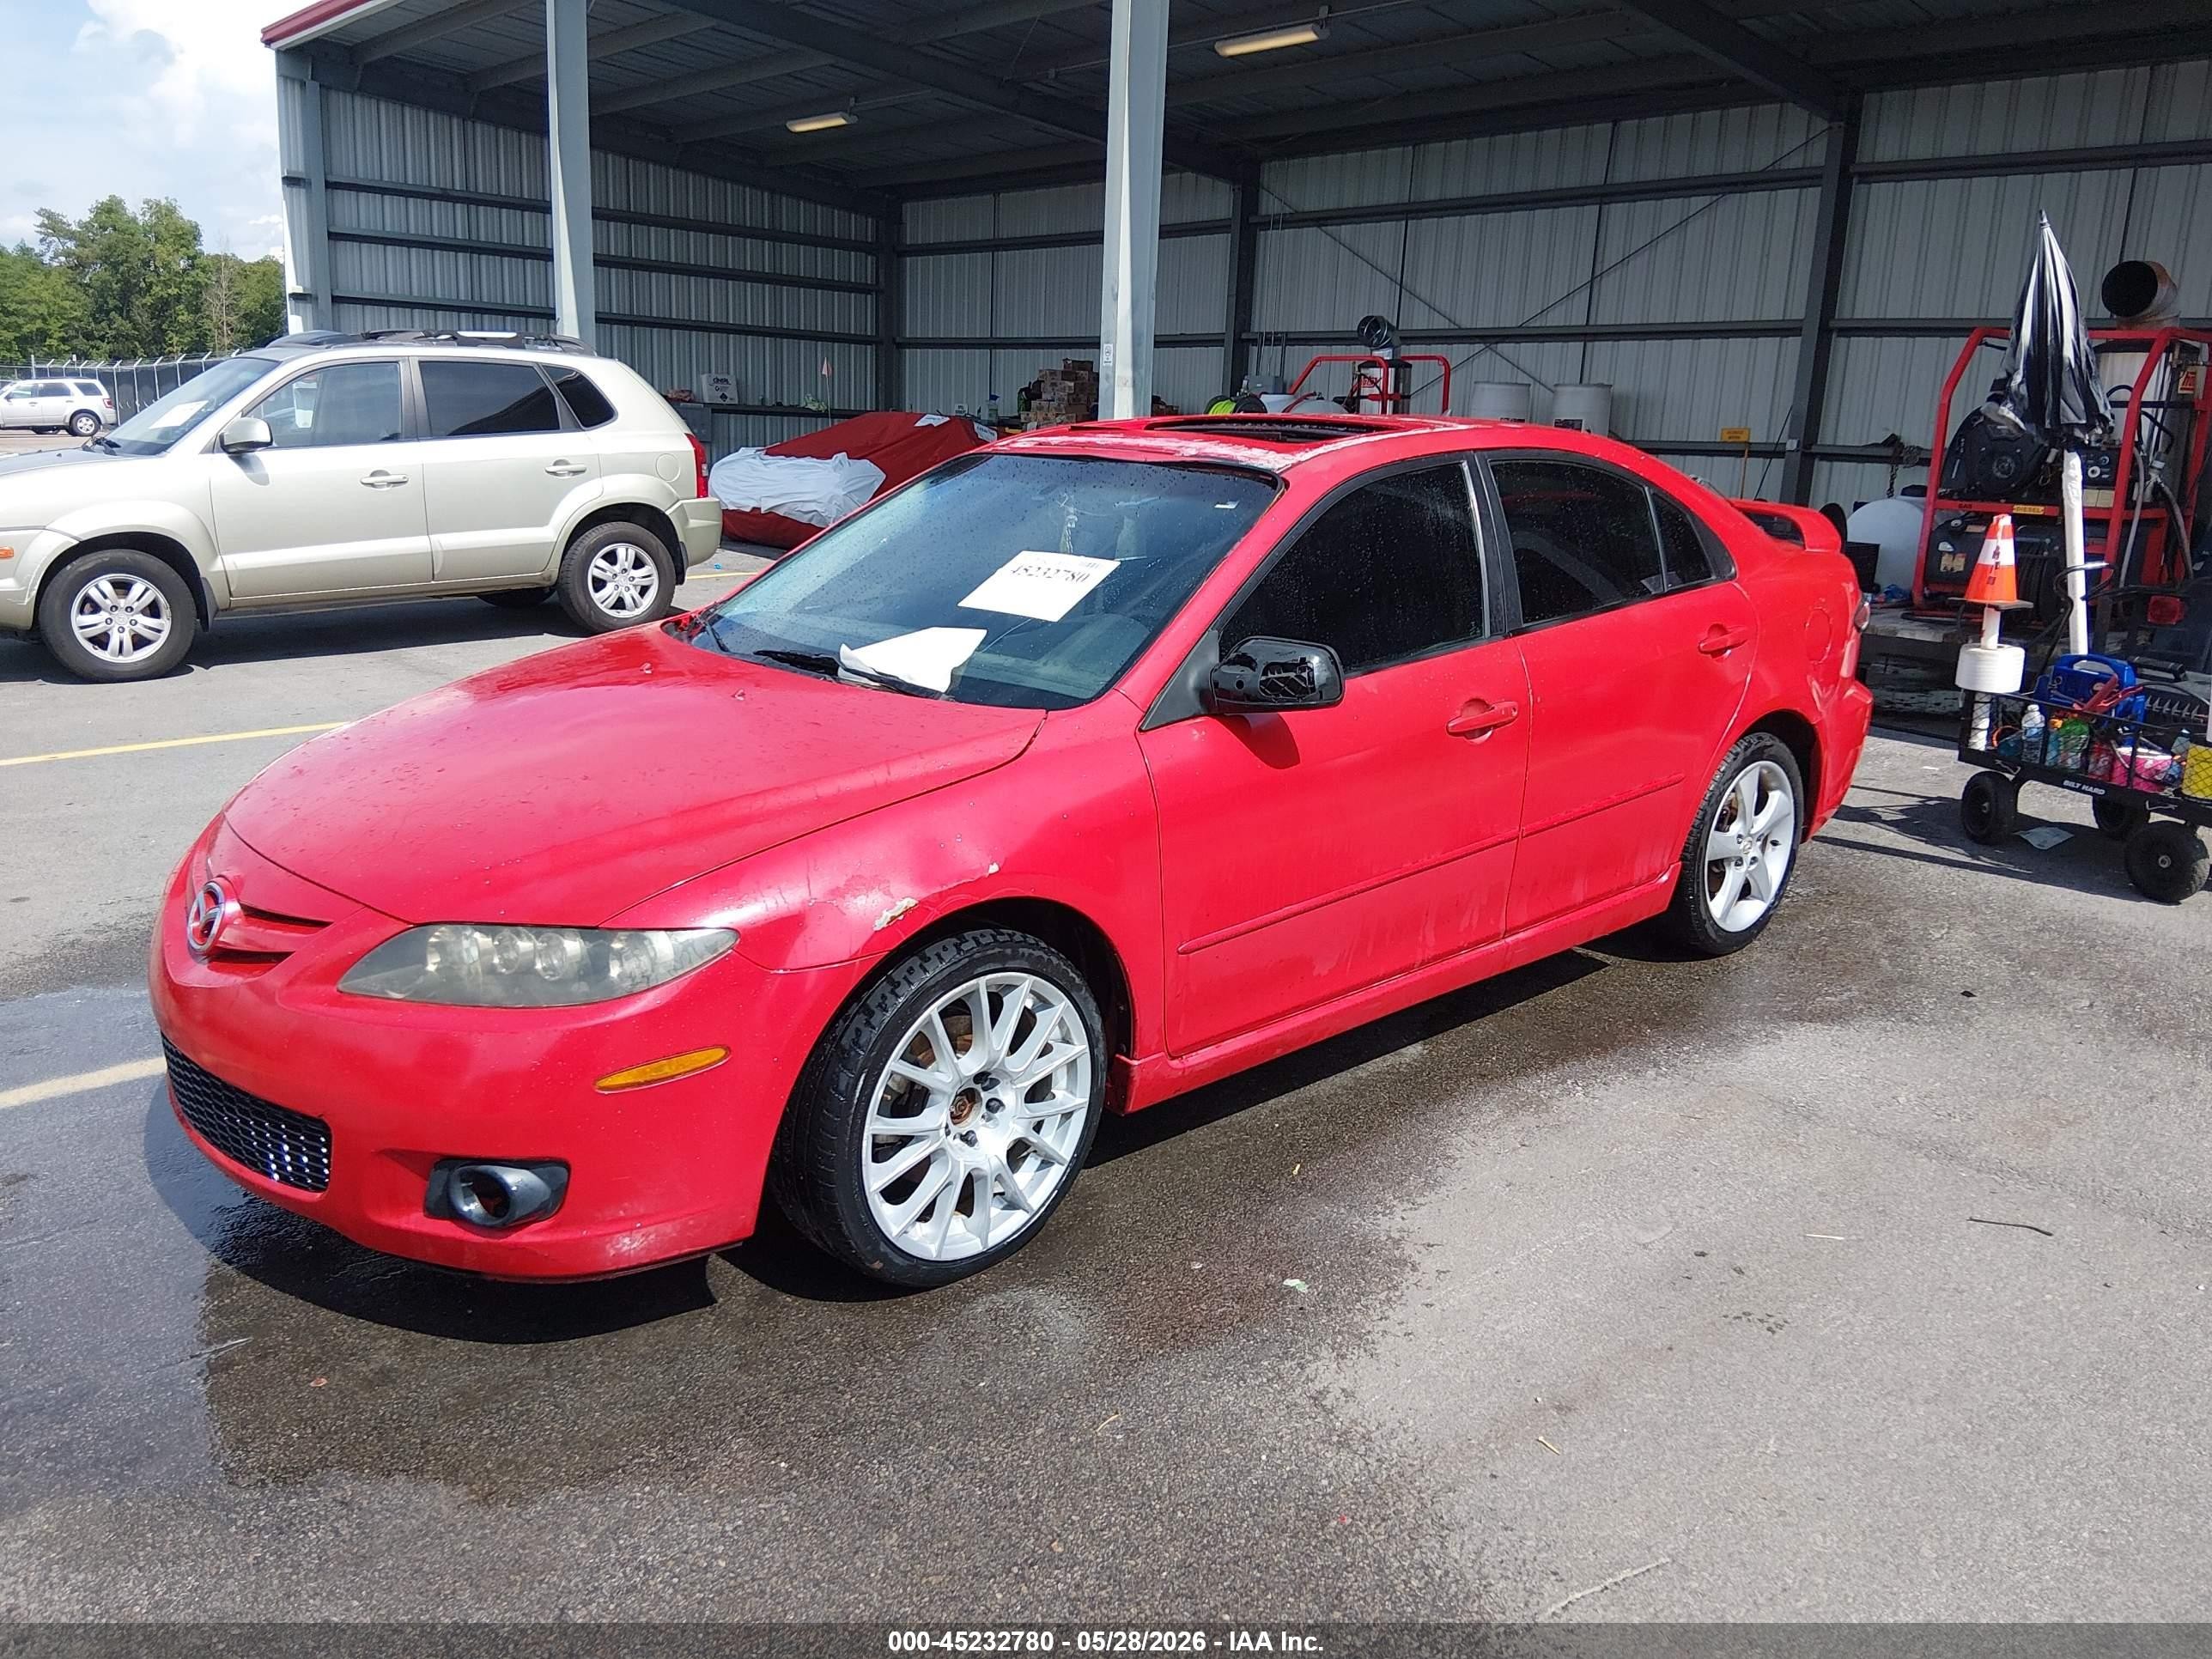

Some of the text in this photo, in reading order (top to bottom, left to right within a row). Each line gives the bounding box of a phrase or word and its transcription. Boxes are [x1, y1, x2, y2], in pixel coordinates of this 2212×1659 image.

[2015, 505, 2041, 514] DIESEL
[2063, 779, 2106, 795] BILT HARD
